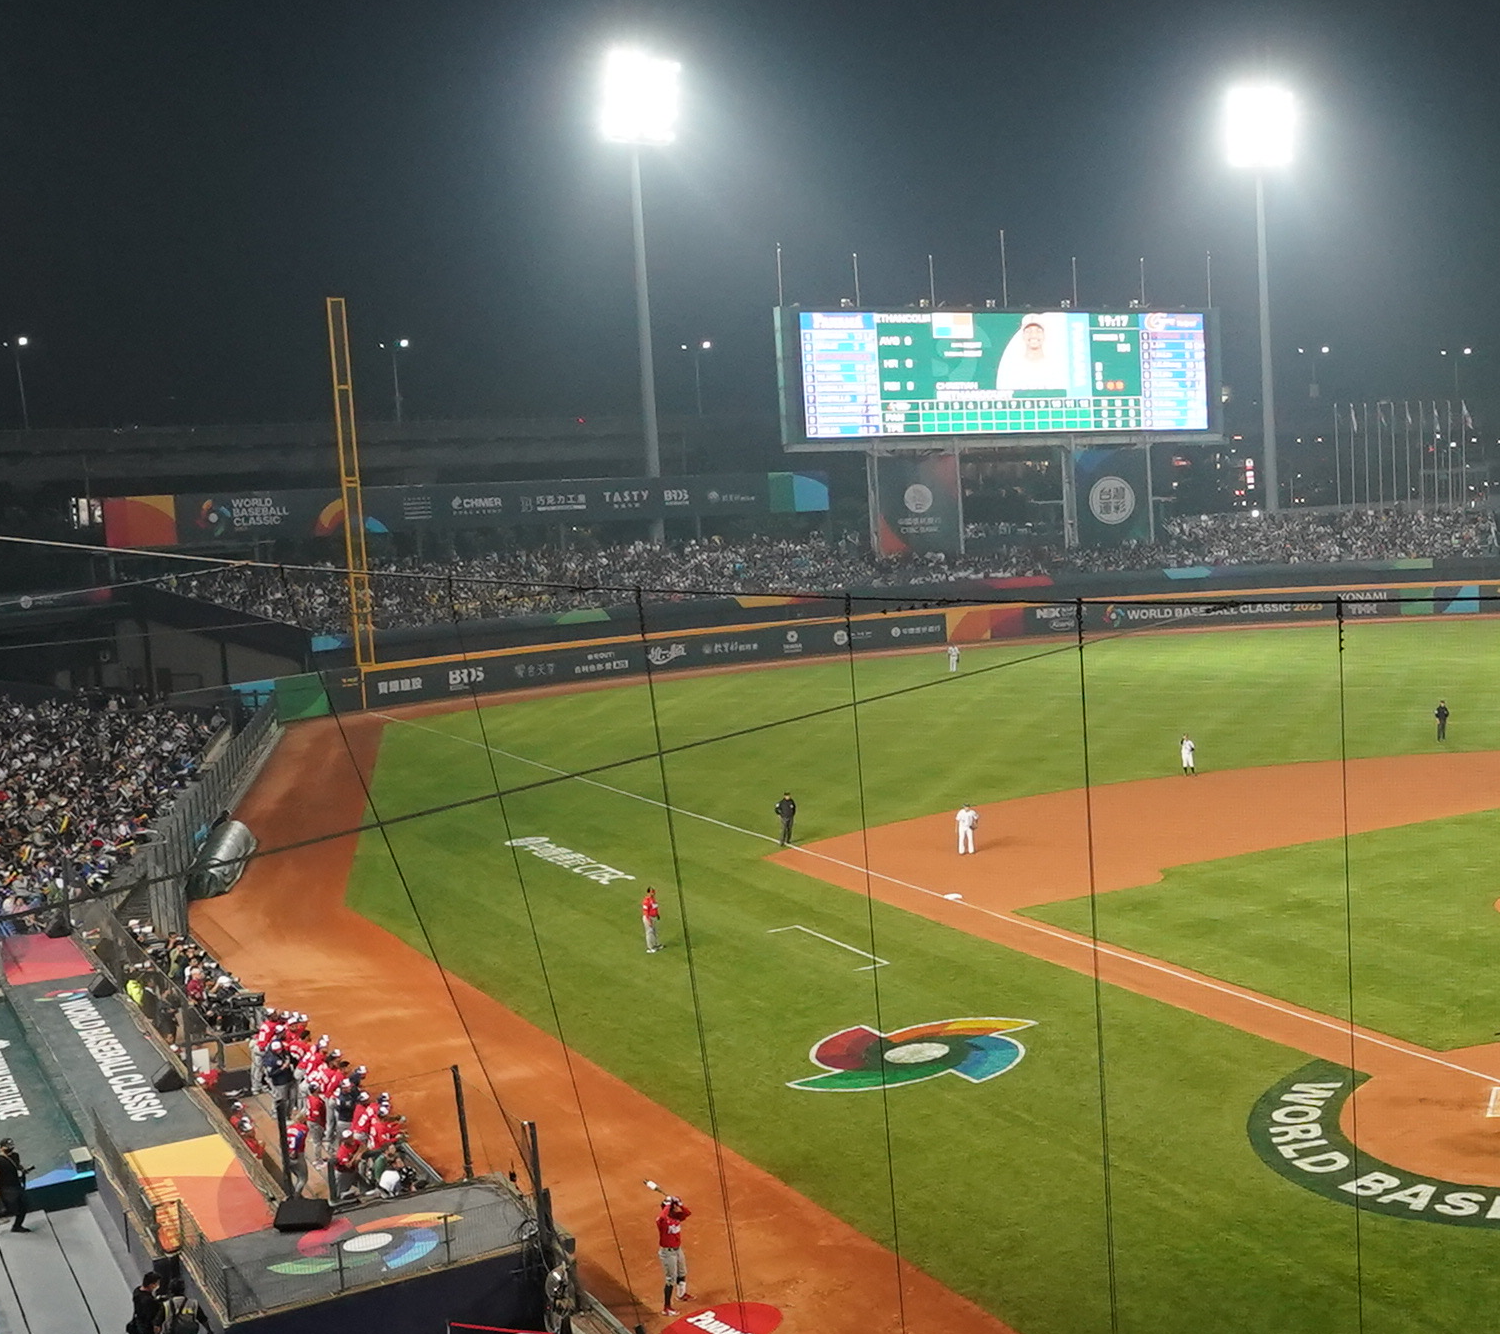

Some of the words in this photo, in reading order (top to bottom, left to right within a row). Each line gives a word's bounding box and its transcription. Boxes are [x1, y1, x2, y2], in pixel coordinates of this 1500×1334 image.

[1098, 315, 1129, 327] 19:17
[603, 490, 650, 503] TASTY
[231, 497, 273, 509] WORLD
[232, 507, 289, 518] BASEBALL
[233, 516, 282, 527] CLASSIC
[1127, 608, 1172, 620] WORLD
[1240, 603, 1292, 615] CLASSIC
[58, 998, 94, 1031] WORLD
[79, 1025, 135, 1077] BASEBALL
[108, 1074, 168, 1122] CLASSIC
[1270, 1081, 1349, 1174] WORLD
